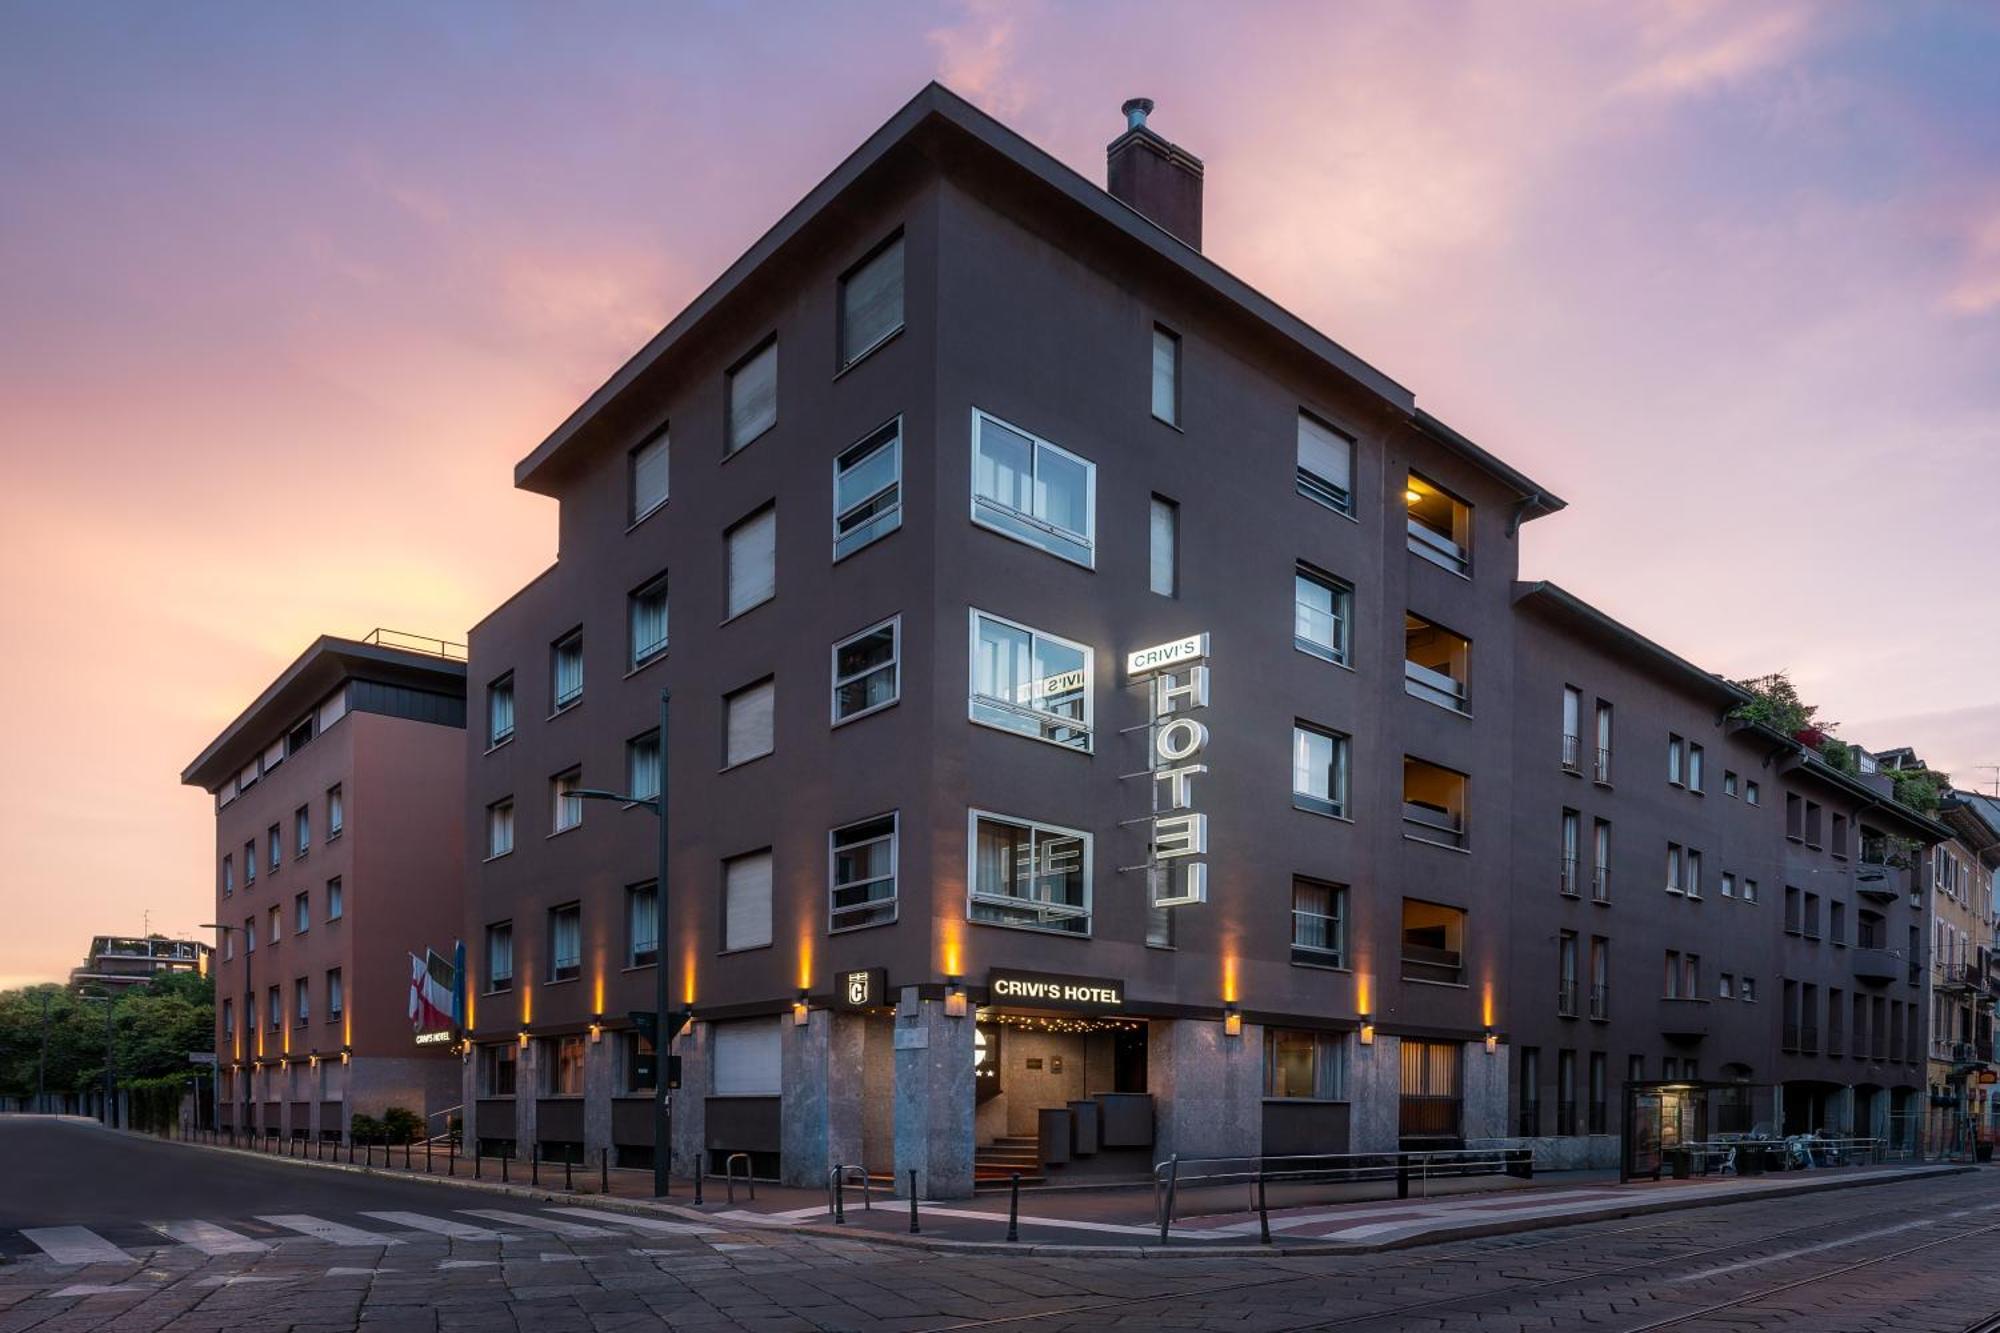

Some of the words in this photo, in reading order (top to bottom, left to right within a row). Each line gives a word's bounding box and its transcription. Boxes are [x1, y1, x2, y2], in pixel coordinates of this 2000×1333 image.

[1134, 641, 1195, 667] CRIVI'S
[994, 979, 1061, 999] CRIVI'S
[1064, 986, 1121, 1004] HOTEL
